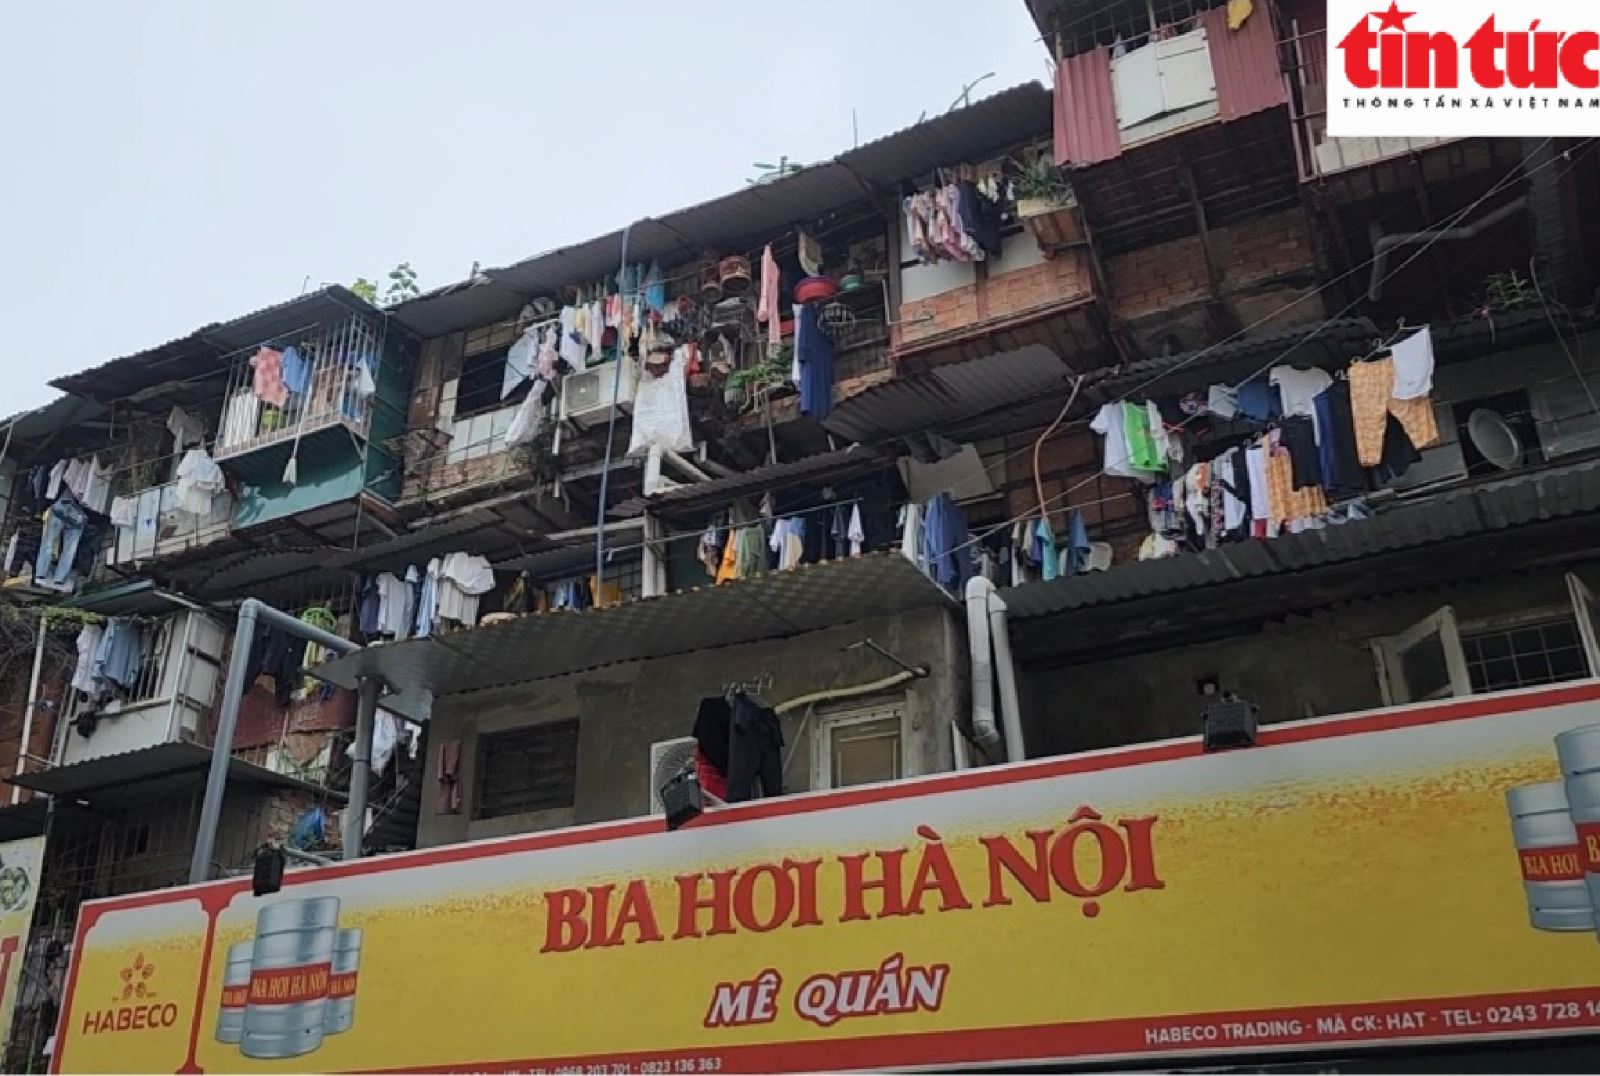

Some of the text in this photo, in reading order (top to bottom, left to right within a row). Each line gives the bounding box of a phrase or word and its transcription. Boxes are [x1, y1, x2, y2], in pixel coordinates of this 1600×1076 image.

[540, 806, 1165, 953] BIA HƠI HÀ NỘI
[82, 1003, 178, 1035] HABECO
[703, 952, 950, 1027] MÊ QUÁN
[1145, 1026, 1217, 1045] HABECO
[1222, 1021, 1302, 1040] TRADING
[1351, 1015, 1383, 1032] CK:
[1386, 1012, 1425, 1030] HAT
[1441, 1009, 1482, 1026] TEL:
[1487, 1005, 1536, 1023] 0243
[1541, 1002, 1581, 1019] 728
